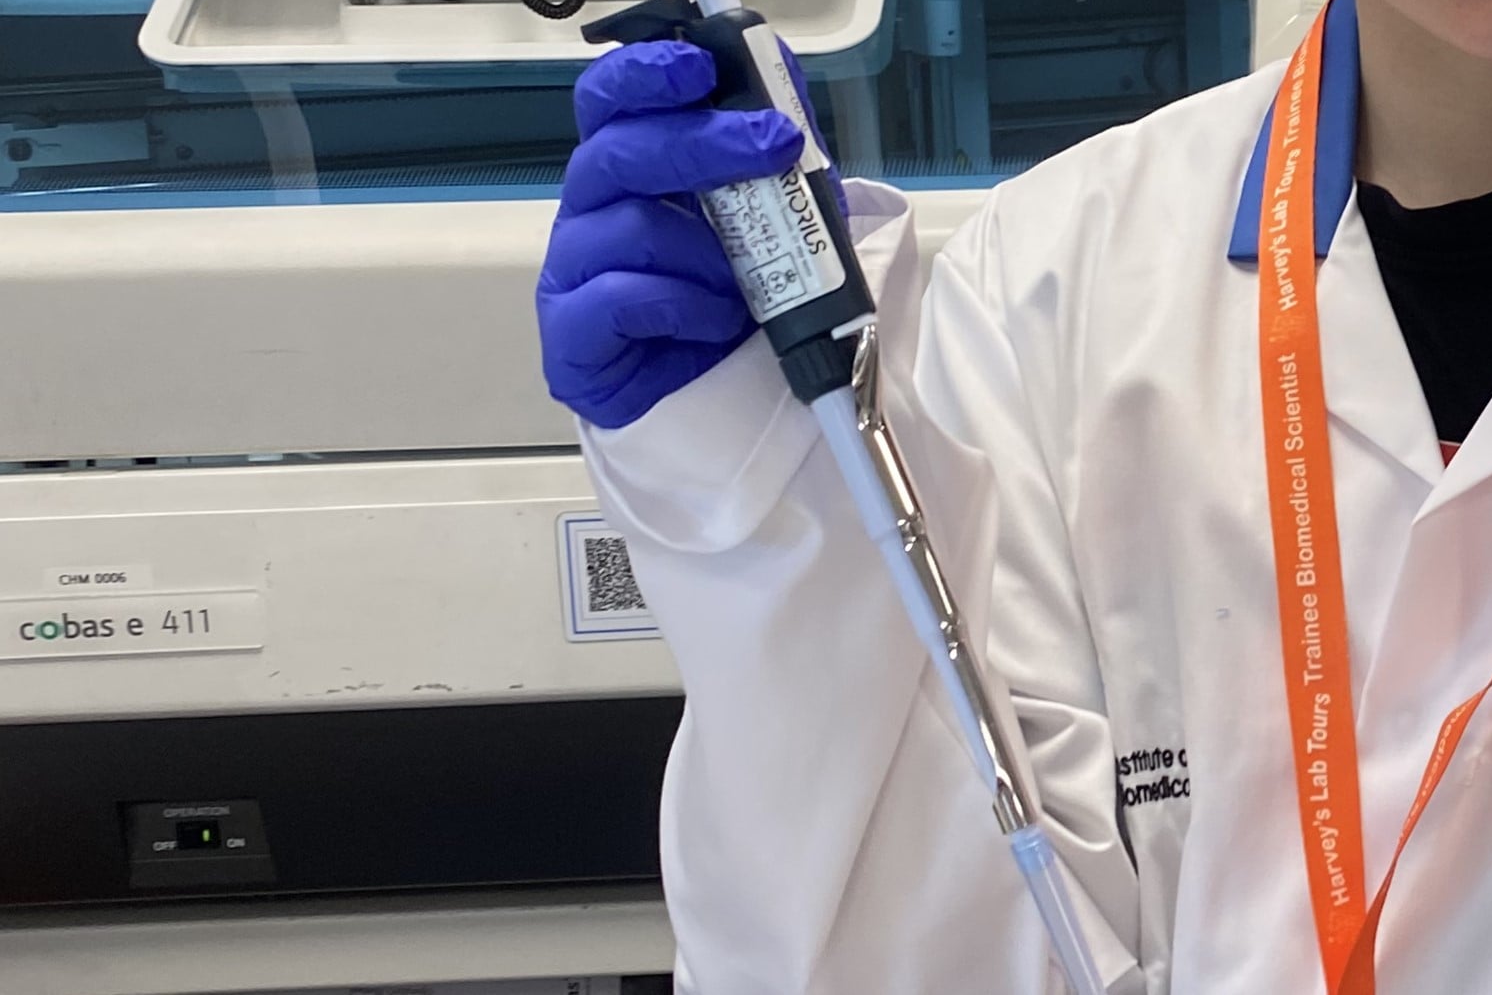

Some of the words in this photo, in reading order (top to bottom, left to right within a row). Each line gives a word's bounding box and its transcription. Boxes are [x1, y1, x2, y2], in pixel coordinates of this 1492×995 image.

[1283, 78, 1303, 149] Trainee
[1274, 148, 1302, 202] Tours
[1269, 199, 1289, 233] Lab
[1267, 234, 1298, 311] Harvey's
[1277, 352, 1304, 451] Scientist
[1285, 457, 1316, 587] Biomedical
[59, 573, 90, 586] CHM
[94, 571, 128, 585] 0006
[19, 612, 115, 641] cobas
[126, 617, 145, 637] e
[161, 608, 211, 635] 411
[1301, 593, 1324, 687] Trainee
[1307, 692, 1331, 754] Tours
[1308, 760, 1329, 802] Lab
[152, 840, 177, 852] OFF
[226, 837, 246, 849] ON
[1313, 807, 1349, 906] Harvey's
